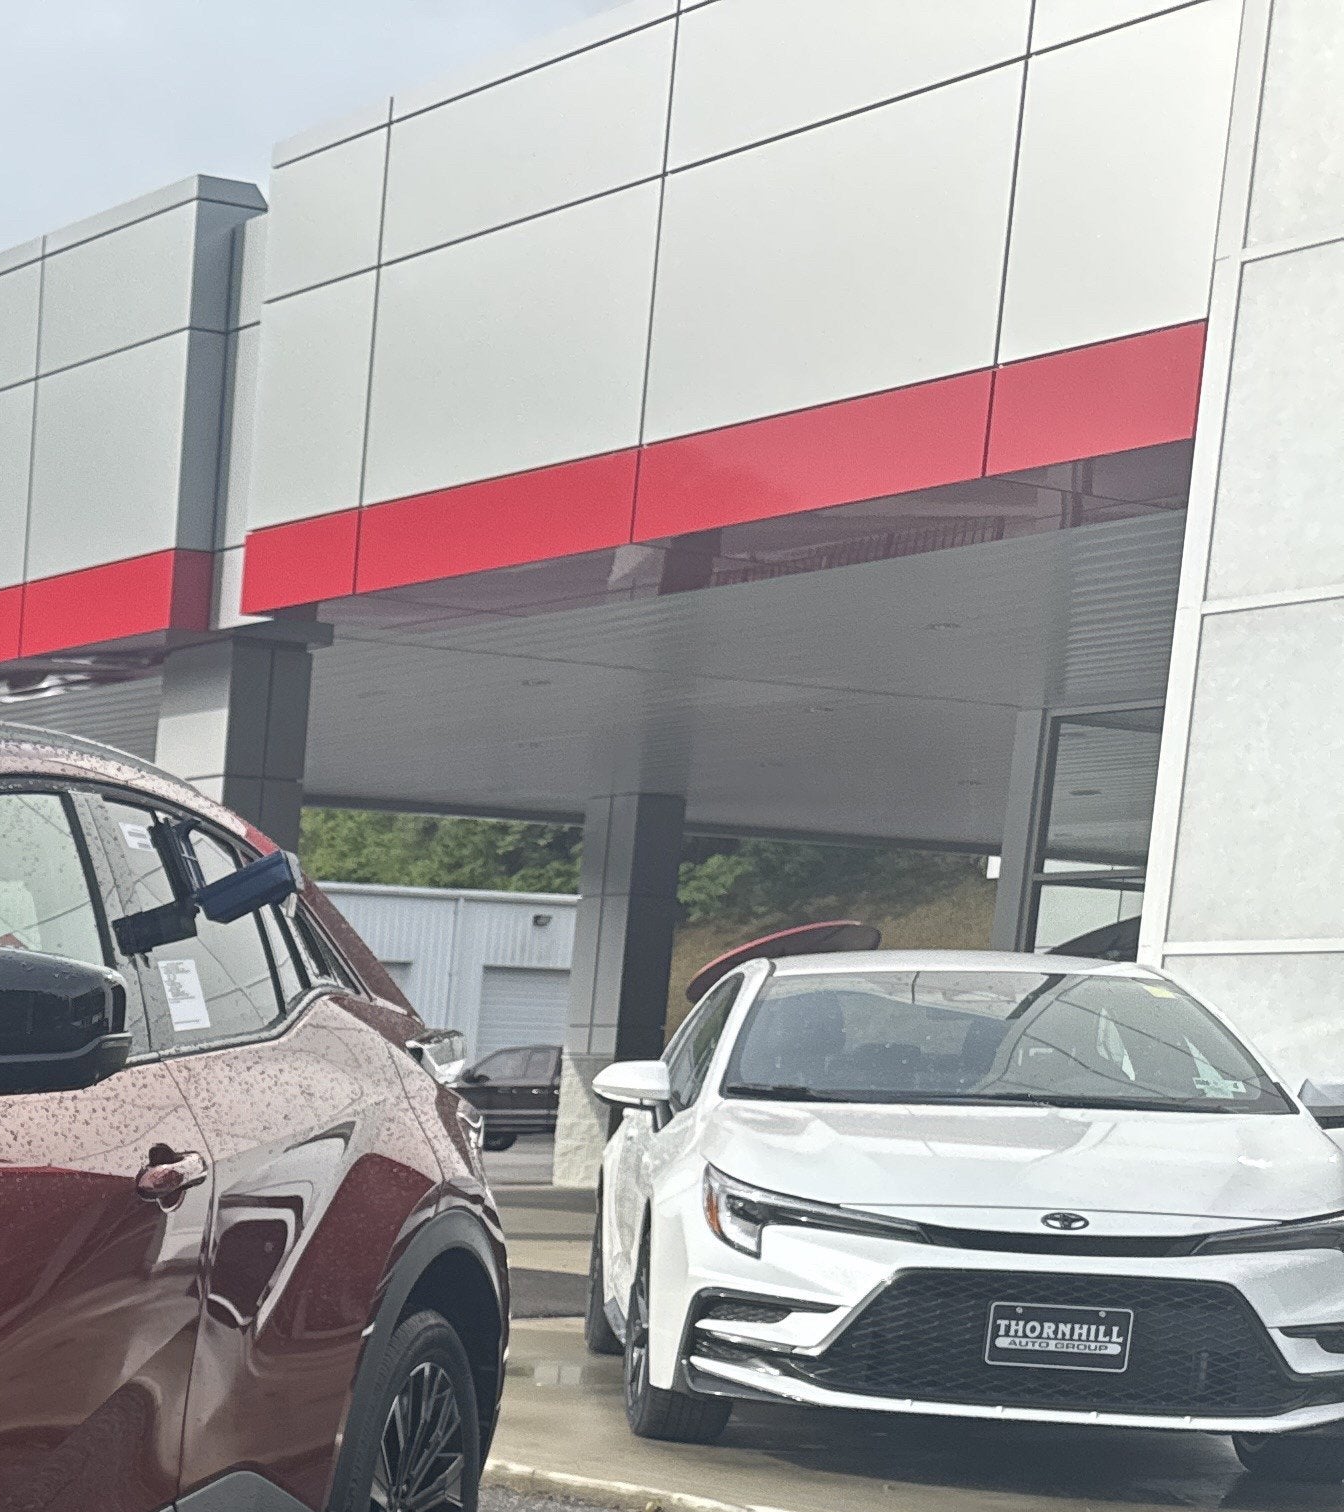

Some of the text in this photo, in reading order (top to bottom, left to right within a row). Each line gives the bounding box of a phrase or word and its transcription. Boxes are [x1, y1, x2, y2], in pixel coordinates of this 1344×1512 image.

[996, 1319, 1124, 1343] THORNHILL
[1008, 1338, 1109, 1352] AUTO GROUP
